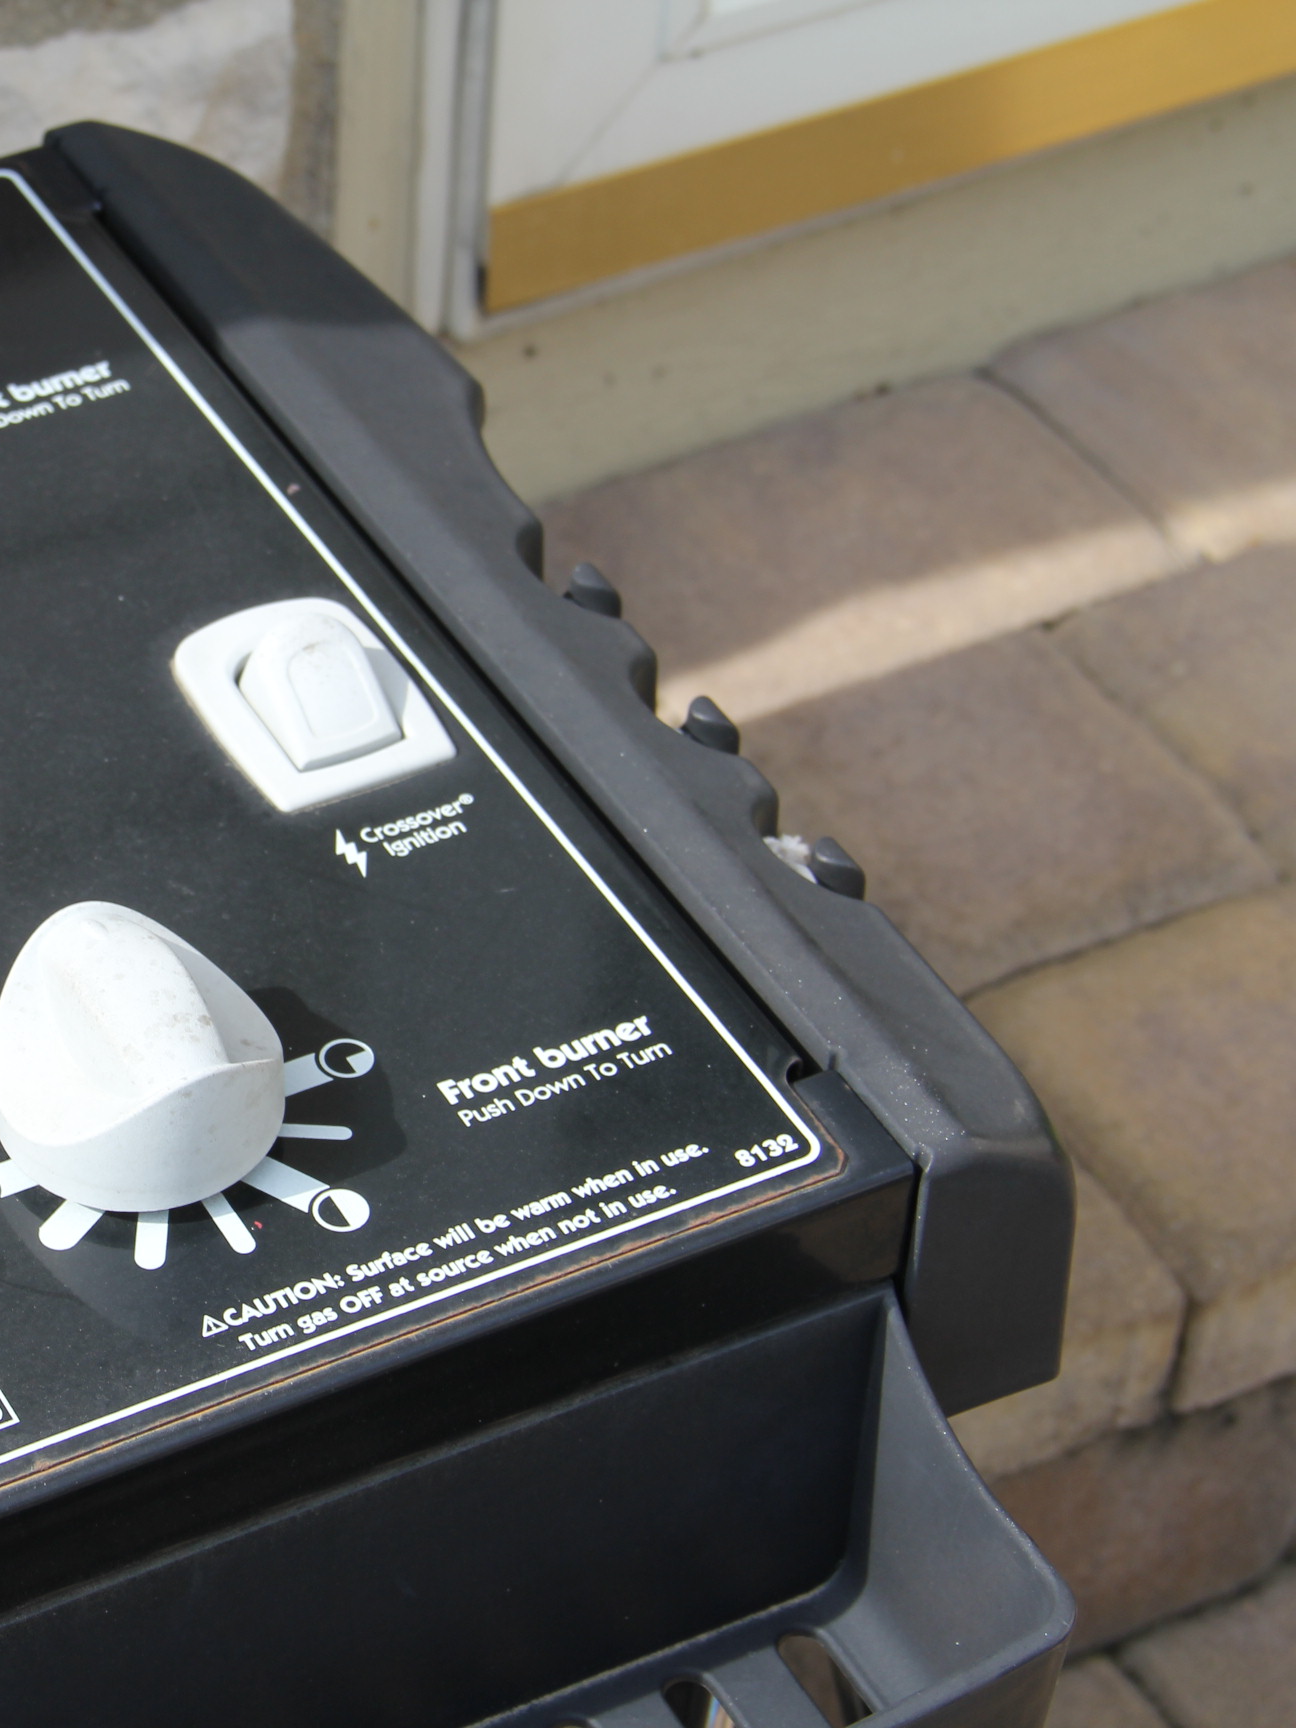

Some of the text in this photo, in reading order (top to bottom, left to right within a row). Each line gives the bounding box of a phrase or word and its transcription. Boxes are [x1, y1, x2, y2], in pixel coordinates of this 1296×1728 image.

[7, 360, 111, 402] burner
[51, 393, 83, 410] To
[80, 379, 131, 401] Turn
[382, 821, 468, 857] Ignition
[436, 1015, 652, 1106] Front burner
[457, 1042, 673, 1127] Push Down To Turn
[734, 1133, 799, 1168] 8132
[345, 1242, 434, 1282] Surface
[432, 1222, 476, 1250] will
[474, 1214, 511, 1234] be
[510, 1191, 572, 1221] warm
[570, 1168, 635, 1199] when
[631, 1159, 660, 1177] in
[660, 1143, 709, 1167] use.
[238, 1185, 677, 1351] Turn gas OFF at source when not in use.
